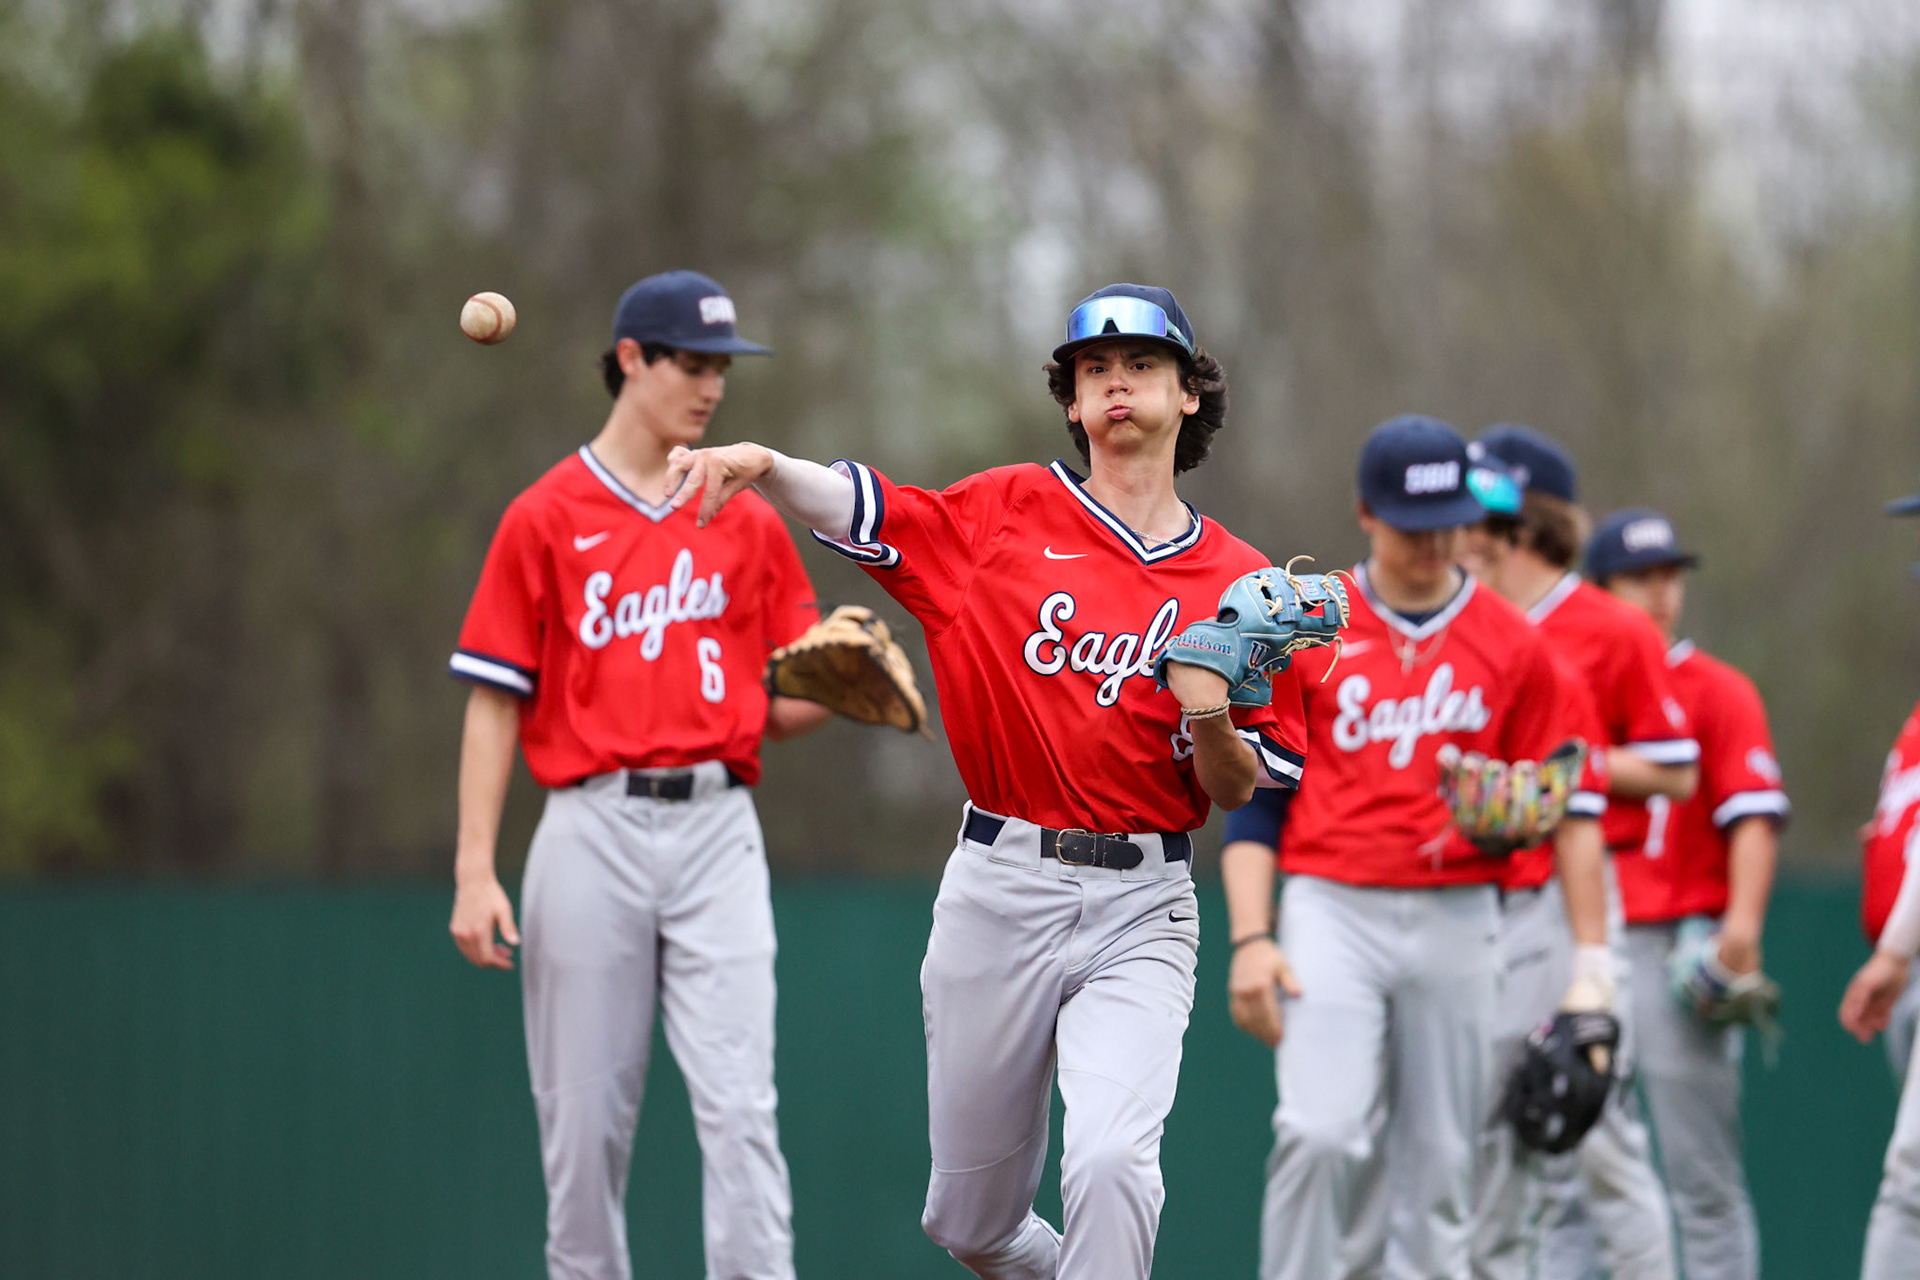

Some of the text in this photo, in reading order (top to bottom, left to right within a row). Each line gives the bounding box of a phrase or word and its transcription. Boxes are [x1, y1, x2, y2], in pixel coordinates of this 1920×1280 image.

[579, 548, 730, 662] Eagles
[1023, 591, 1180, 708] Eagl
[1177, 632, 1232, 656] Wilson
[697, 637, 725, 703] 6
[1332, 662, 1490, 770] Eagles
